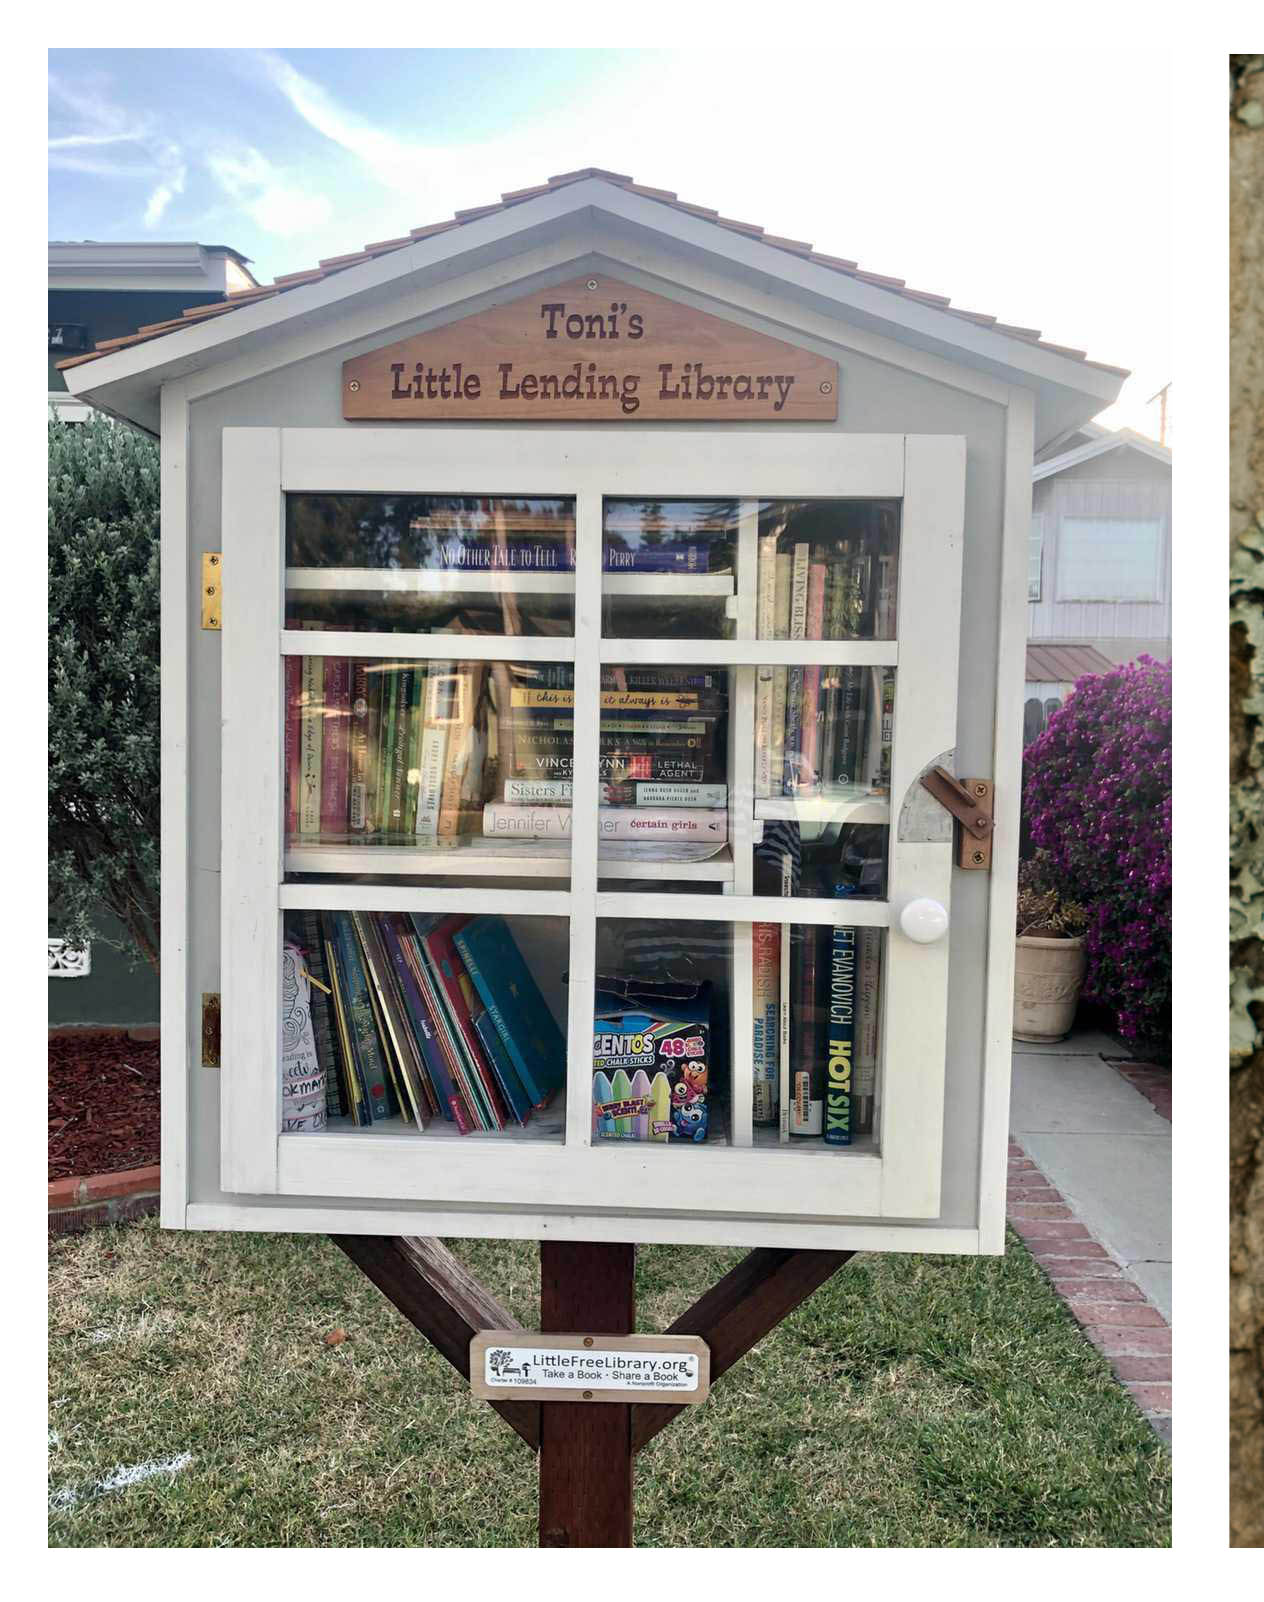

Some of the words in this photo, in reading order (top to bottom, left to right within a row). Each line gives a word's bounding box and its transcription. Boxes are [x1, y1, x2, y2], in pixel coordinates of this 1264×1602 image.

[541, 303, 645, 339] Toni's
[390, 362, 481, 400] Little
[498, 361, 642, 413] Lending
[658, 362, 795, 411] Library
[533, 544, 558, 566] TELL
[609, 548, 636, 567] PERRY
[599, 759, 626, 769] YNN
[657, 760, 698, 769] LETHAL
[659, 769, 695, 778] AGENT
[511, 783, 556, 797] Sisters
[489, 811, 553, 833] Jennifer
[630, 819, 668, 829] certain
[671, 820, 698, 831] girls
[756, 946, 773, 998] RADISH
[830, 949, 855, 1025] EVANOVICH
[753, 1017, 764, 1065] PARADISE
[765, 1003, 776, 1058] SEARCHING
[593, 1033, 655, 1057] CENTOS
[659, 1037, 686, 1057] 48
[630, 1056, 654, 1065] STICKS
[764, 1060, 775, 1080] FOR
[828, 1039, 852, 1093] HOT
[827, 1093, 850, 1131] SIX
[533, 1354, 688, 1373] LittleFreeLibrary.org
[542, 1368, 565, 1379] Take
[568, 1371, 575, 1379] a
[577, 1369, 603, 1380] Book
[612, 1370, 642, 1381] Share
[644, 1372, 651, 1380] a
[653, 1371, 679, 1382] Book
